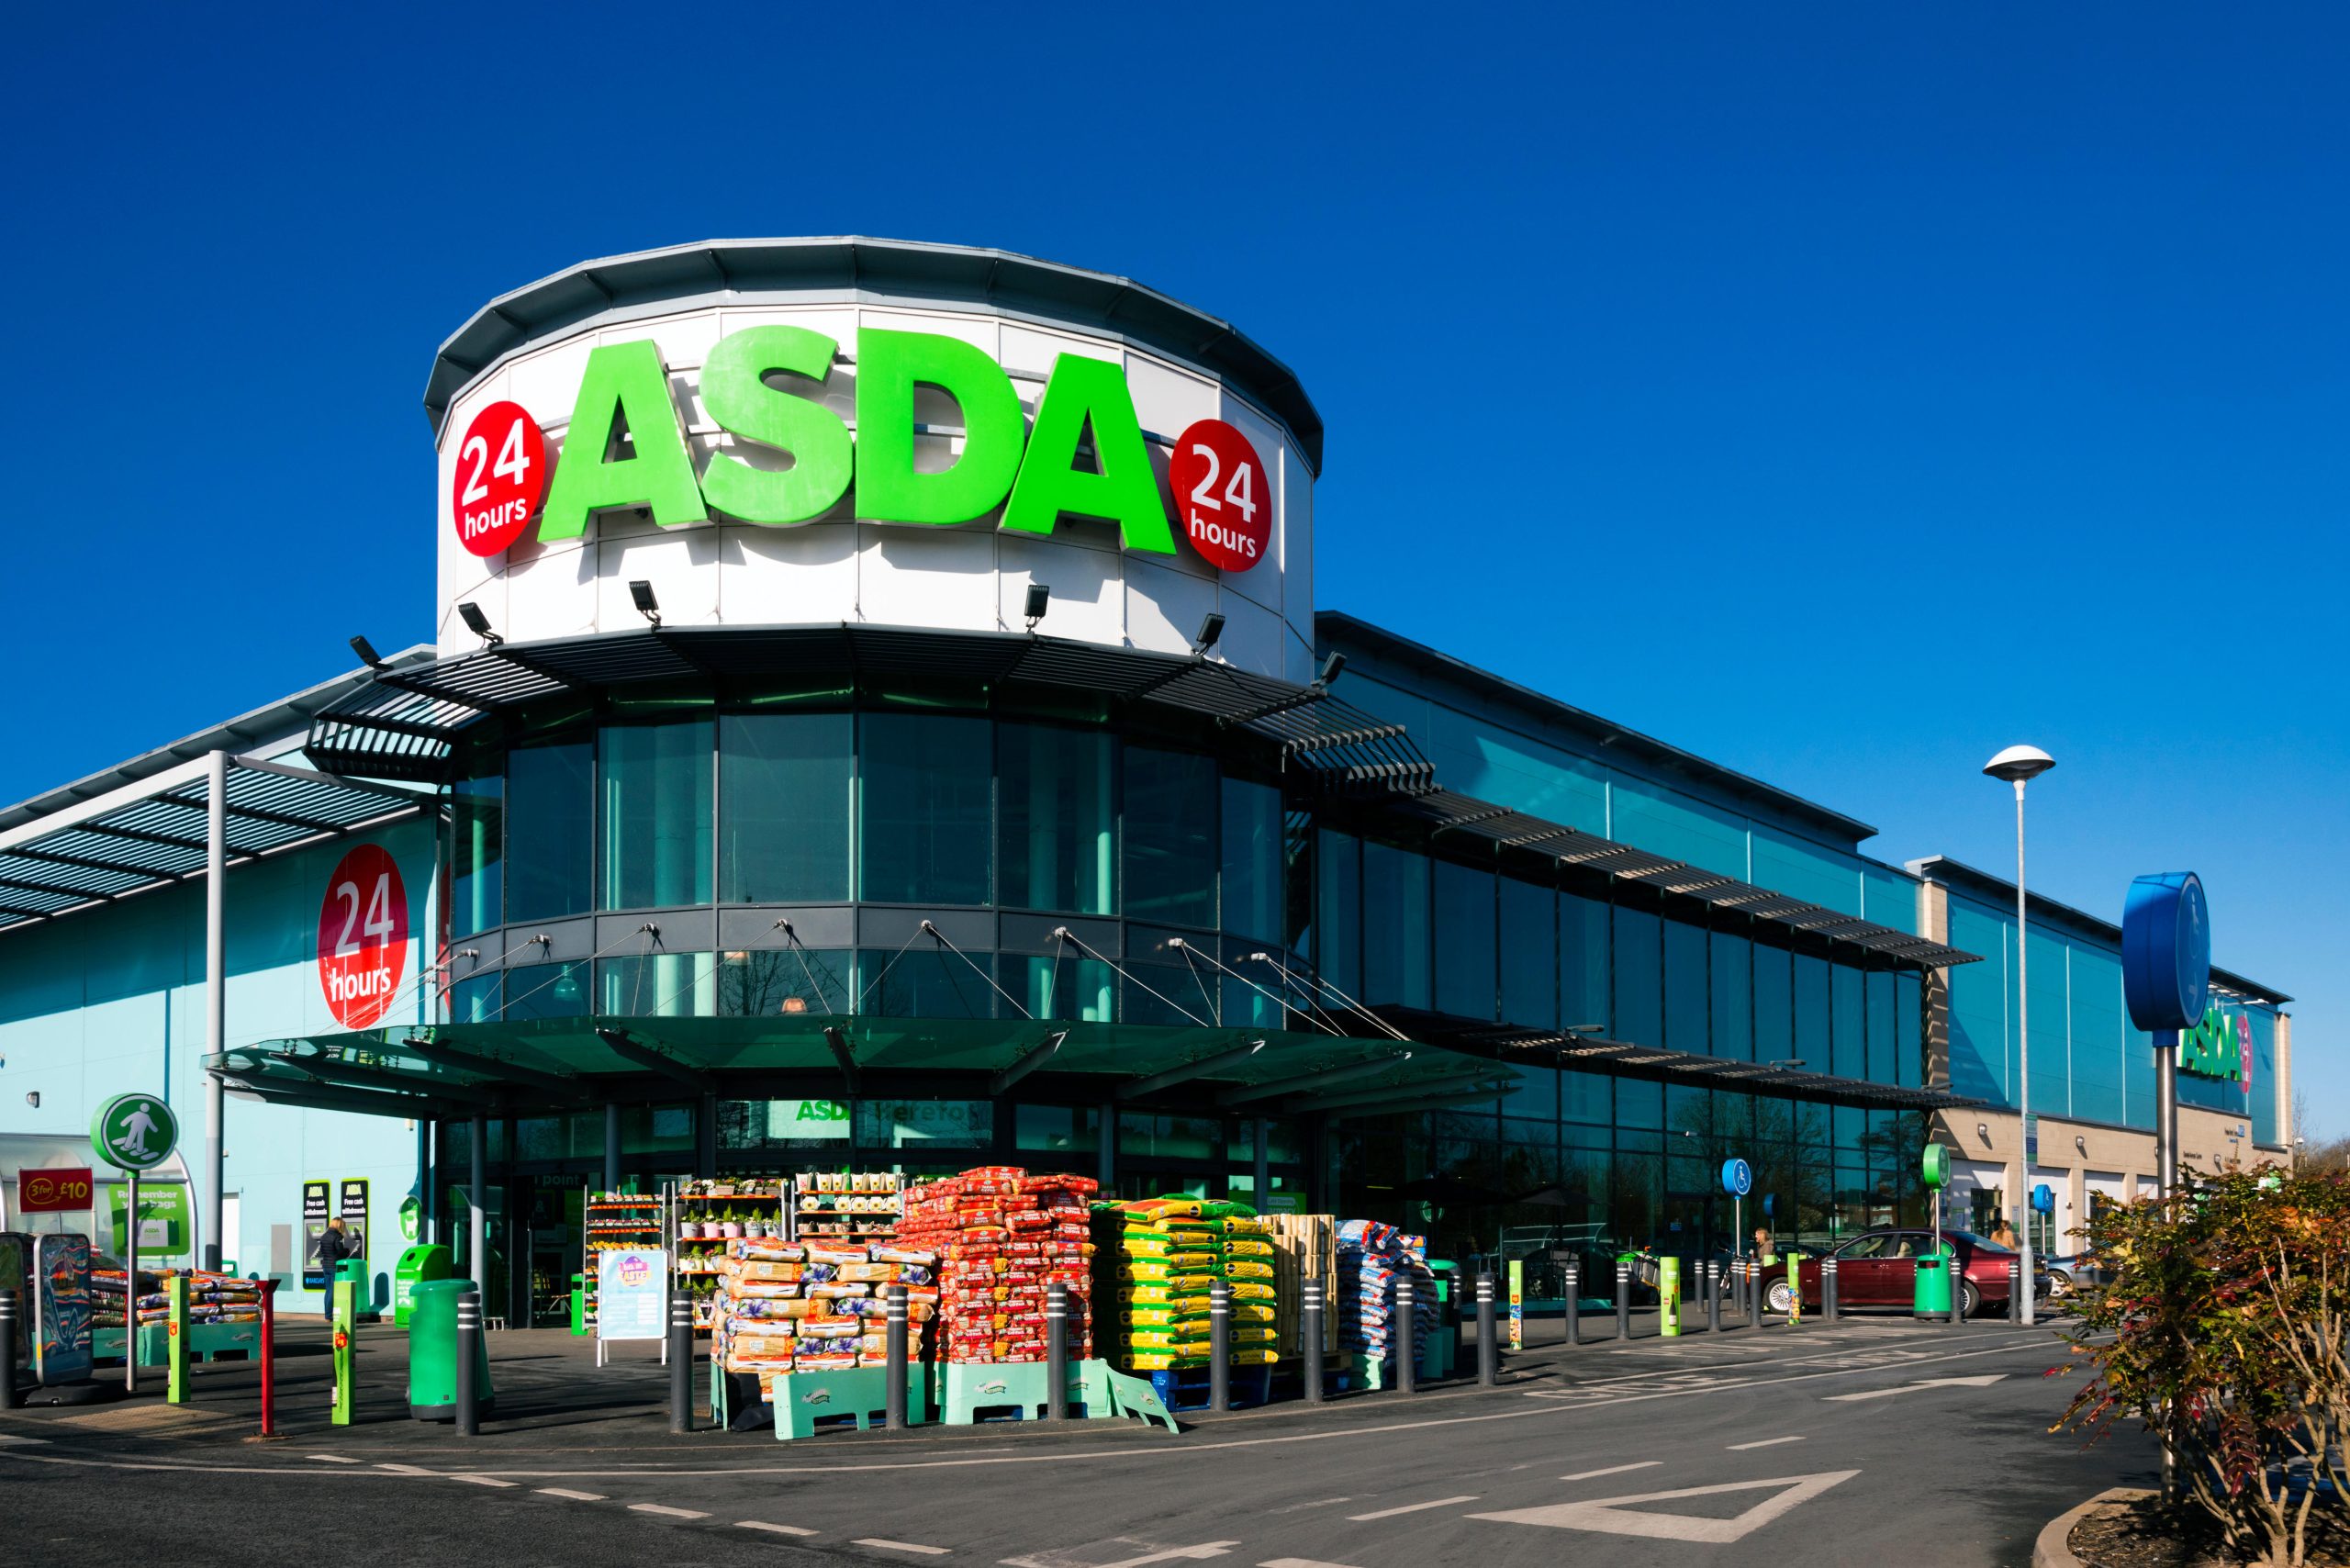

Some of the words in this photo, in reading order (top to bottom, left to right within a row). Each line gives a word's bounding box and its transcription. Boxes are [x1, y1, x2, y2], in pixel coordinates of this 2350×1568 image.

[463, 418, 530, 507] 24
[538, 324, 1177, 556] ASDA
[1191, 443, 1256, 523] 24
[464, 498, 527, 541] hours
[1191, 508, 1256, 558] hours
[335, 872, 394, 958] 24
[331, 966, 391, 1002] hours
[2177, 1007, 2243, 1081] ASDA
[796, 1100, 850, 1121] ASD
[32, 1184, 39, 1196] 3
[39, 1185, 52, 1195] for
[60, 1182, 88, 1200] £10
[118, 1190, 177, 1199] Reember
[1523, 1375, 1751, 1399] CYCLE
[1783, 1350, 1944, 1368] TRACK
